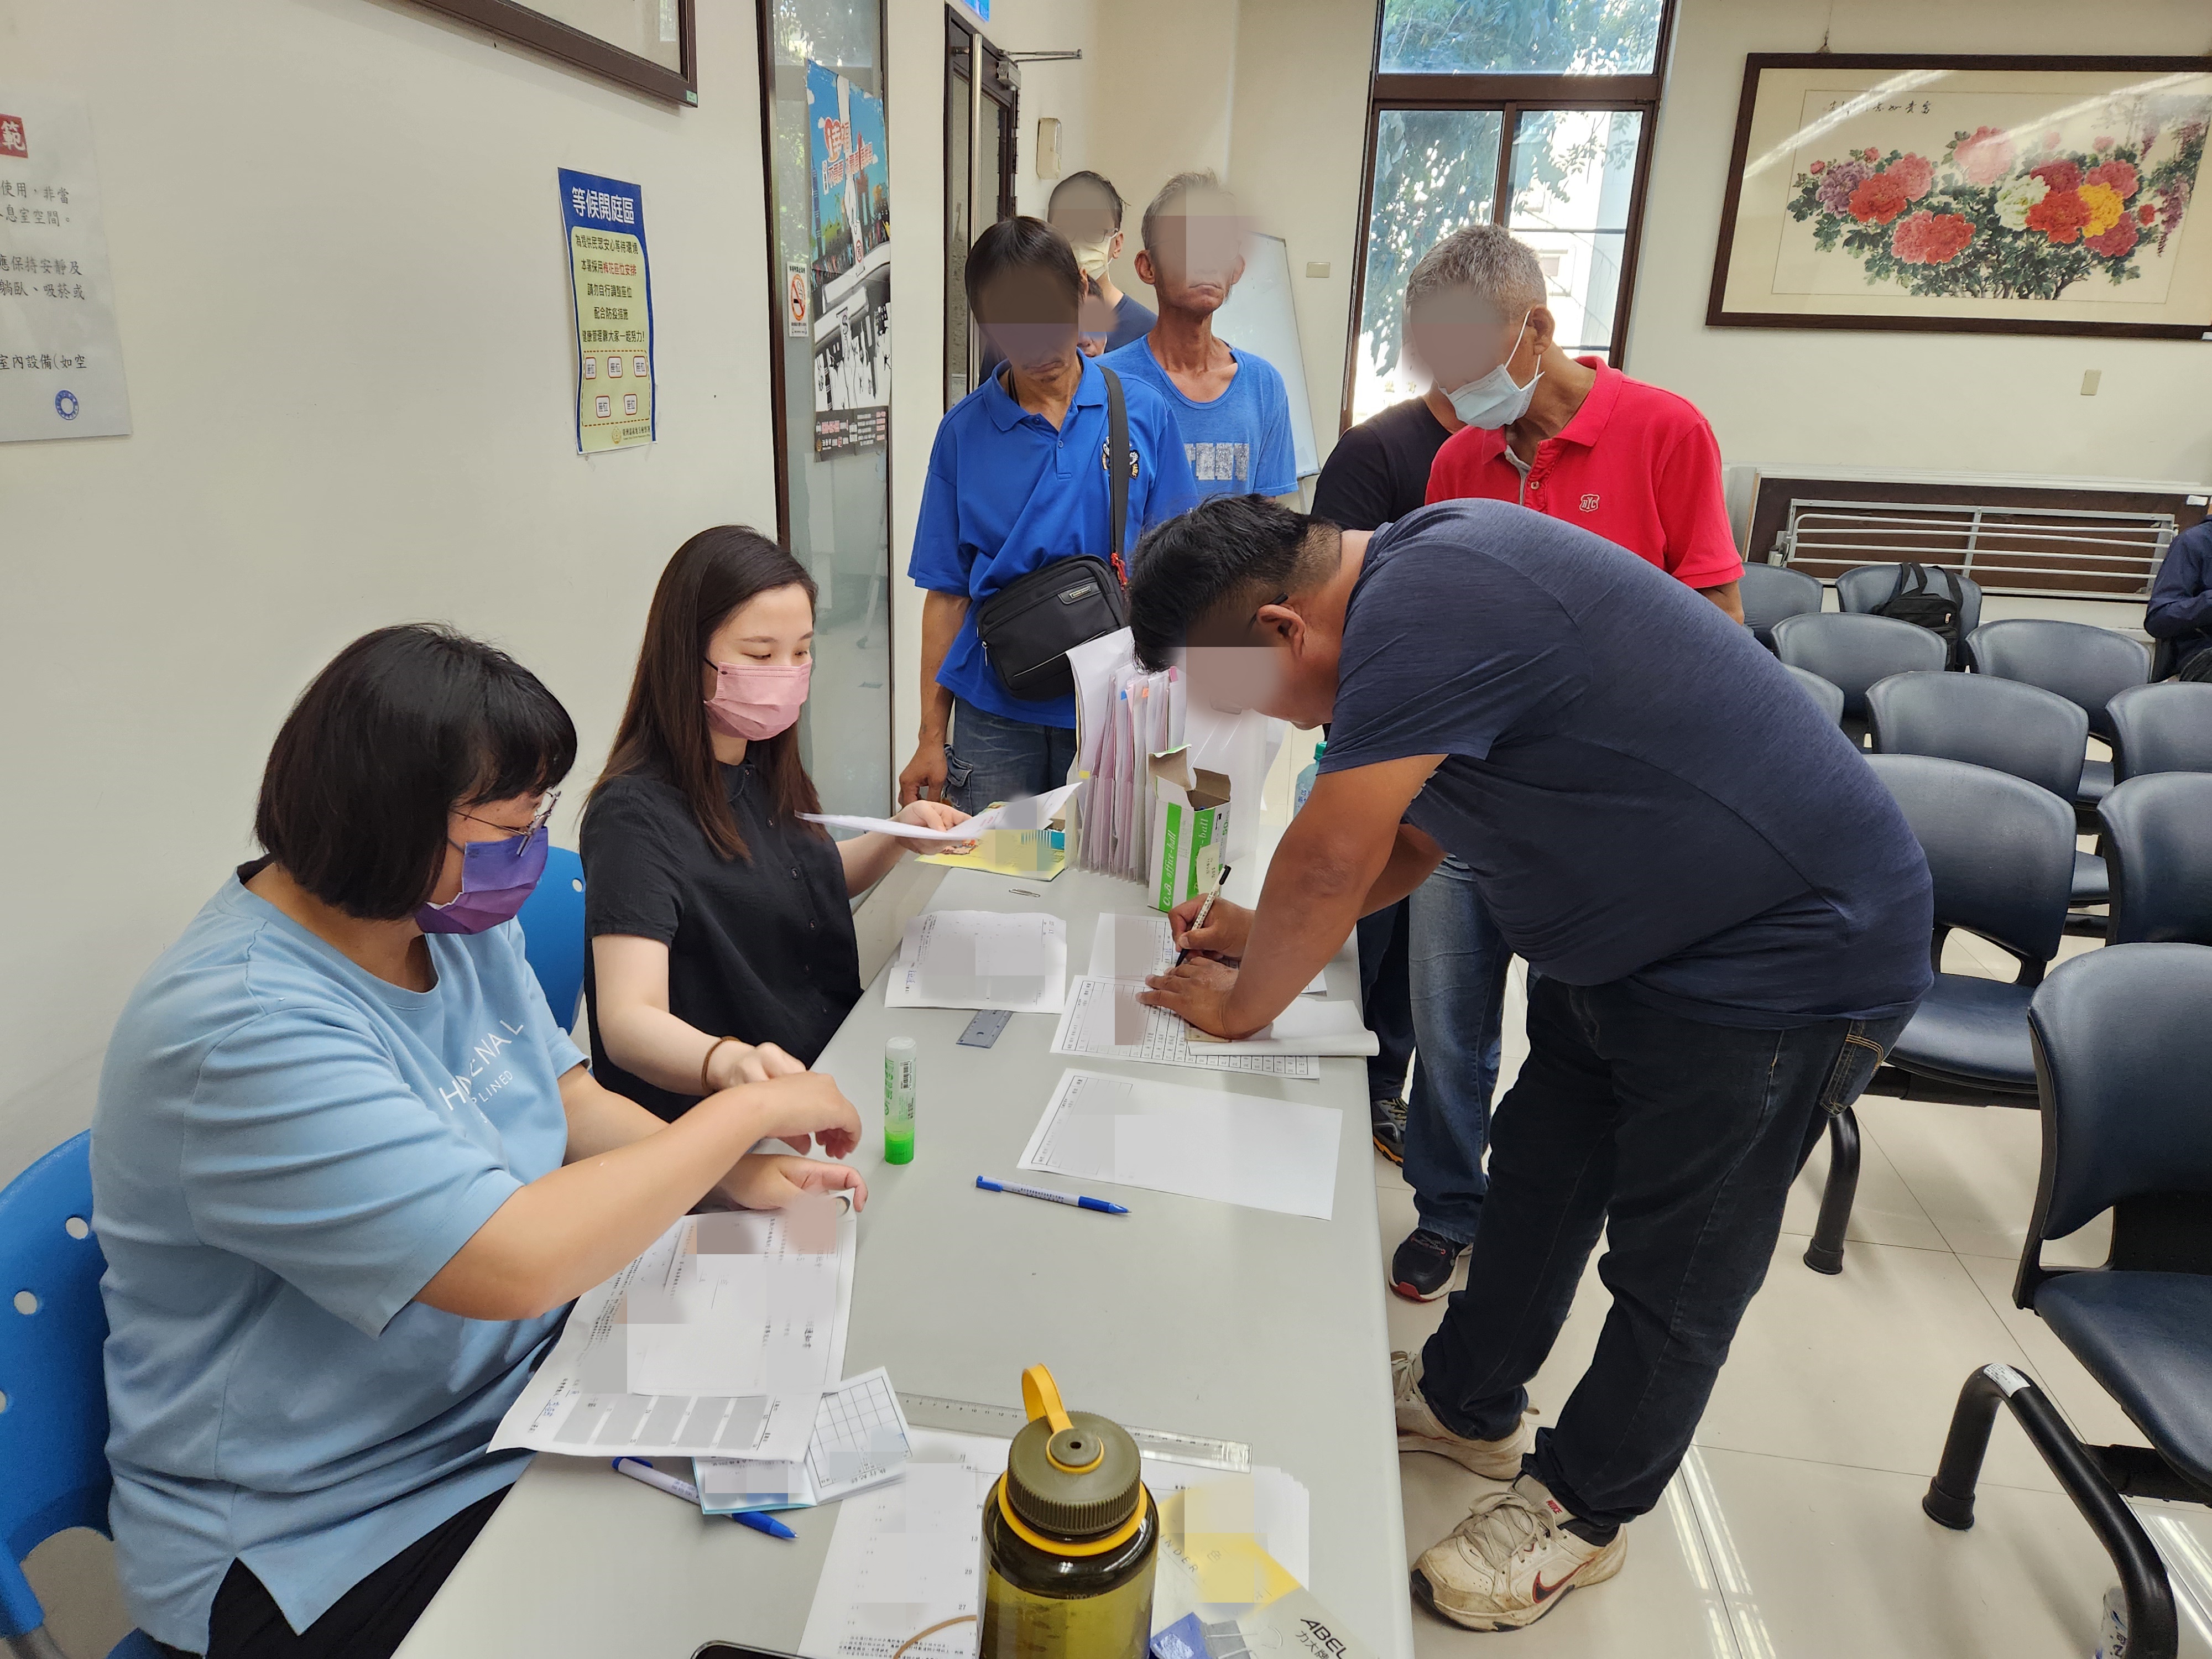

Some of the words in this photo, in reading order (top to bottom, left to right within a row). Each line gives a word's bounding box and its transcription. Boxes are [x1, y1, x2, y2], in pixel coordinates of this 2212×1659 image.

[1, 121, 26, 150] 範
[0, 204, 70, 227] 息室空間。
[572, 186, 635, 225] 等候開庭區
[1582, 497, 1597, 509] NYC
[1300, 1618, 1347, 1659] ABEL
